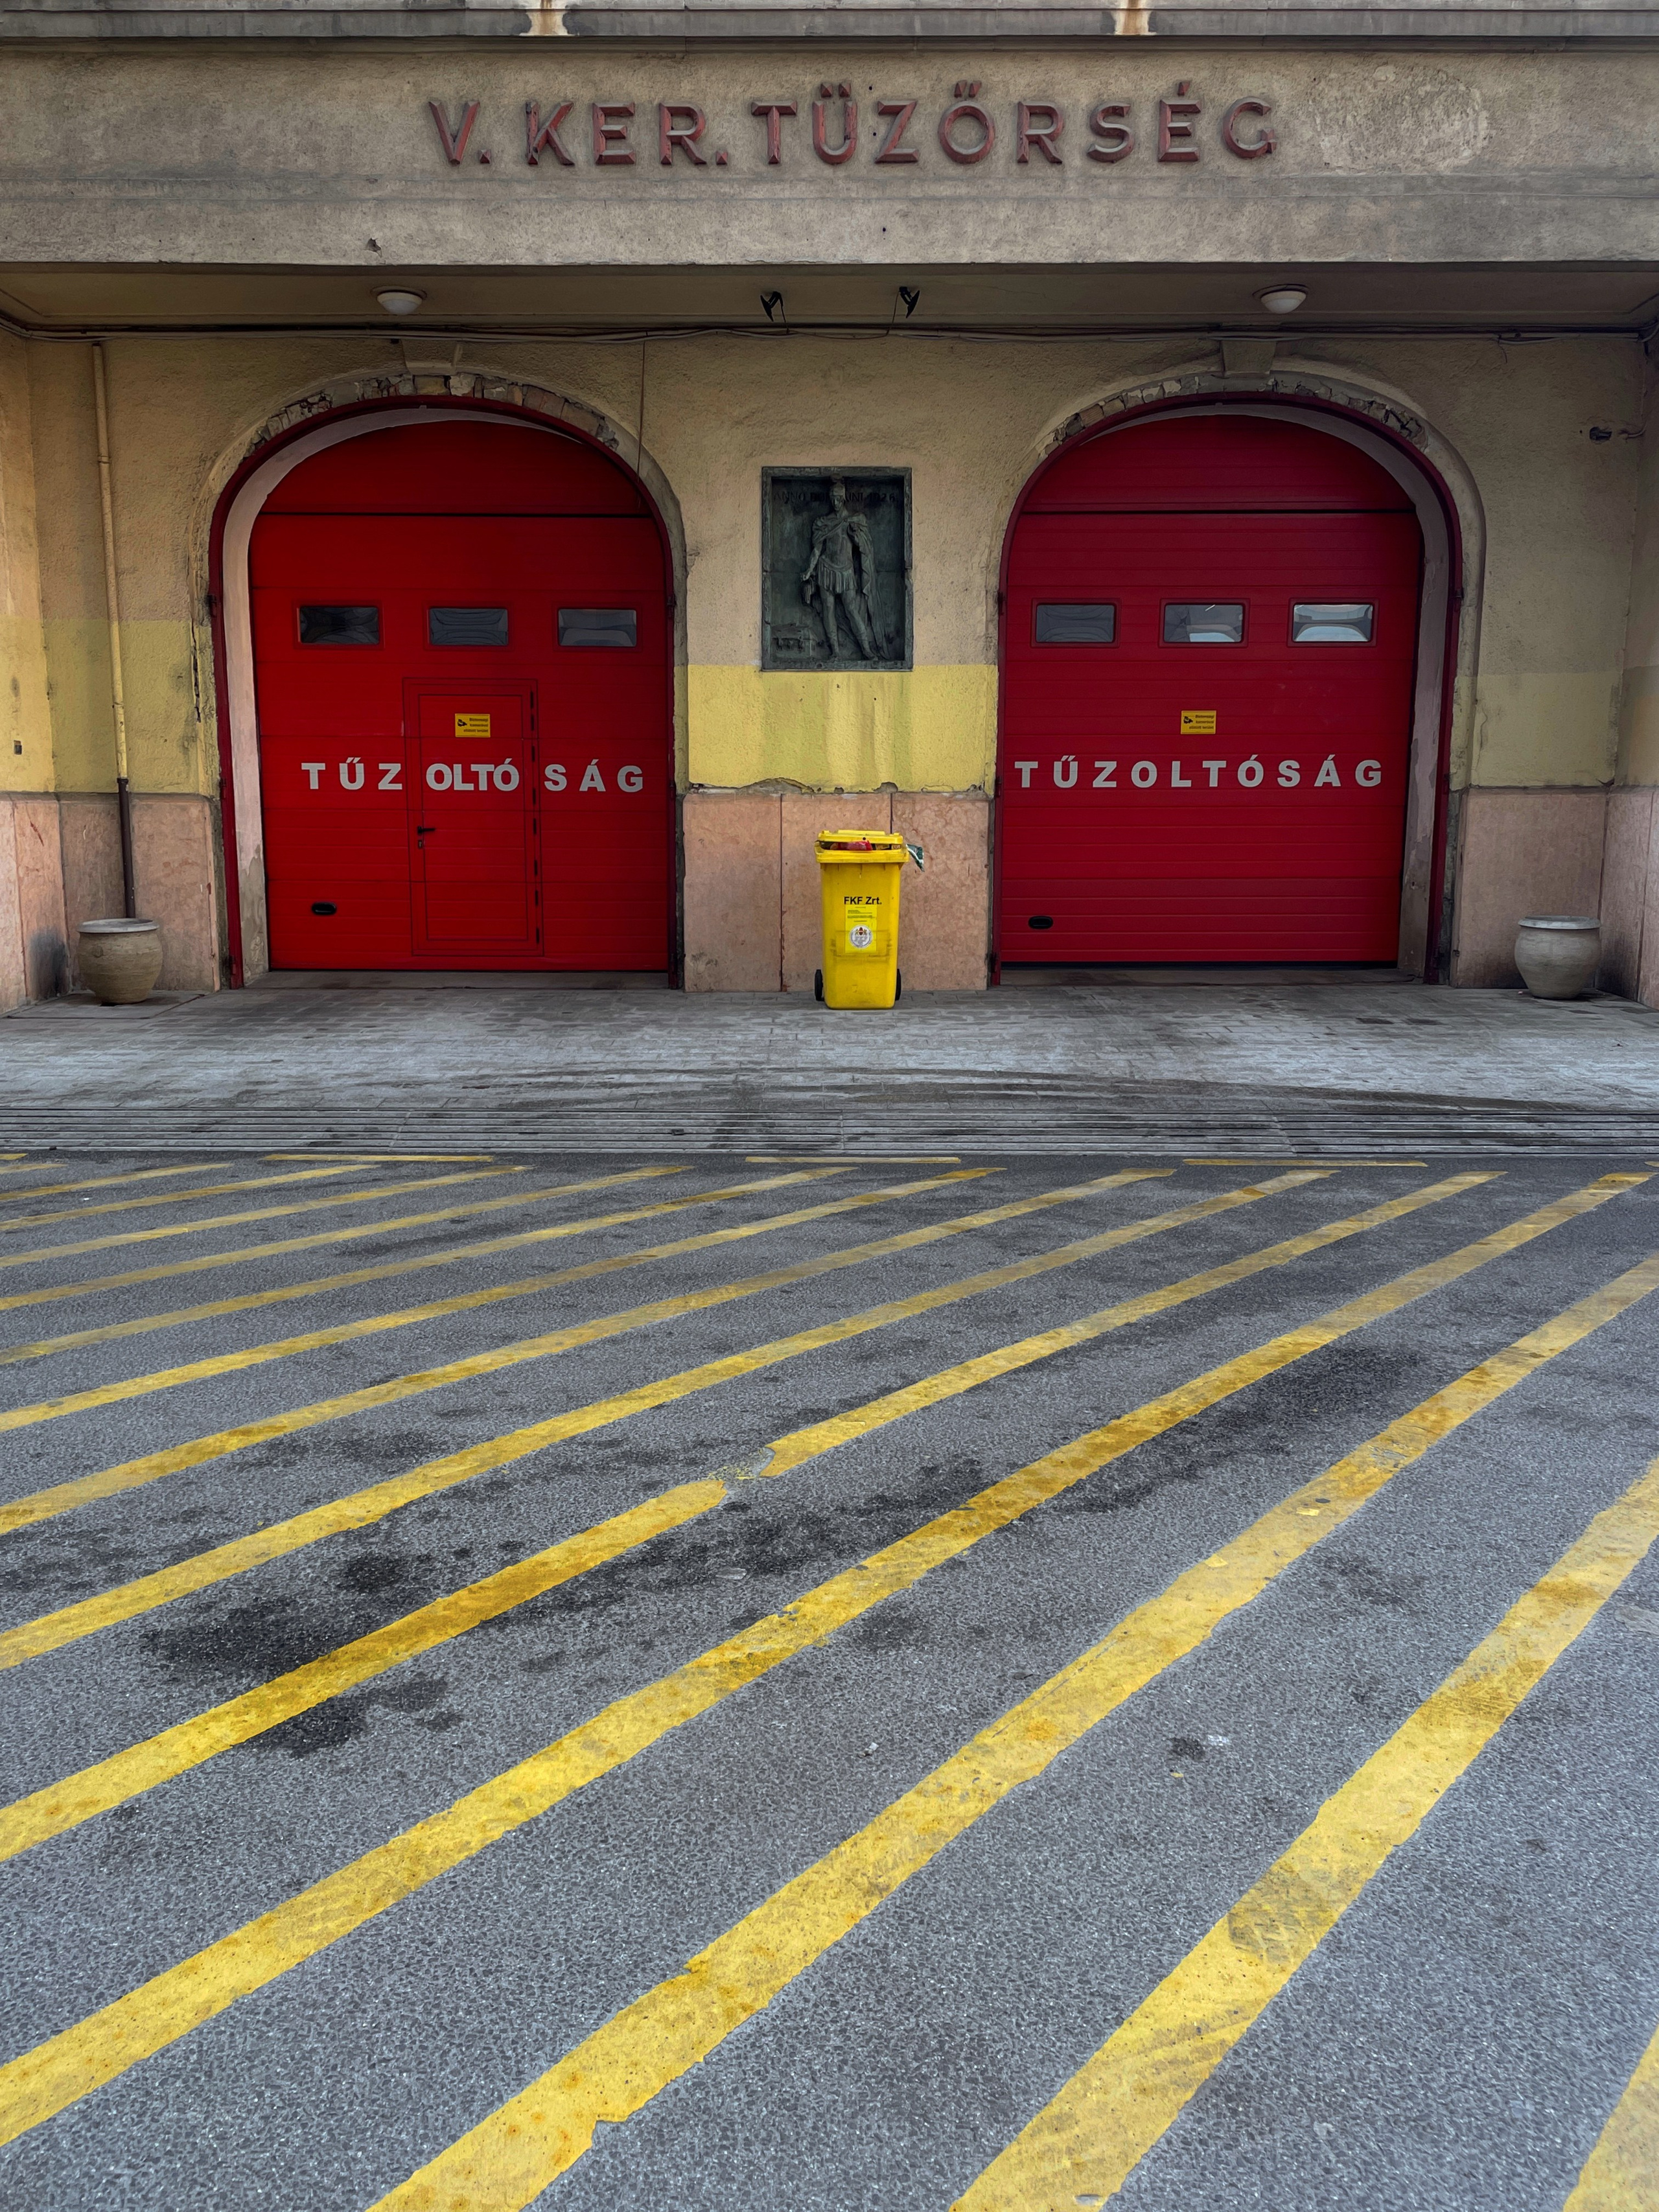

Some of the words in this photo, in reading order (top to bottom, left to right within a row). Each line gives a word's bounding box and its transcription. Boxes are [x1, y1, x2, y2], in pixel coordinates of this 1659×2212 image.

[428, 100, 491, 165] V.
[1014, 754, 1382, 789] TŰZOLTÓSÁG
[844, 896, 863, 905] FKF
[865, 896, 882, 905] Zrt.
